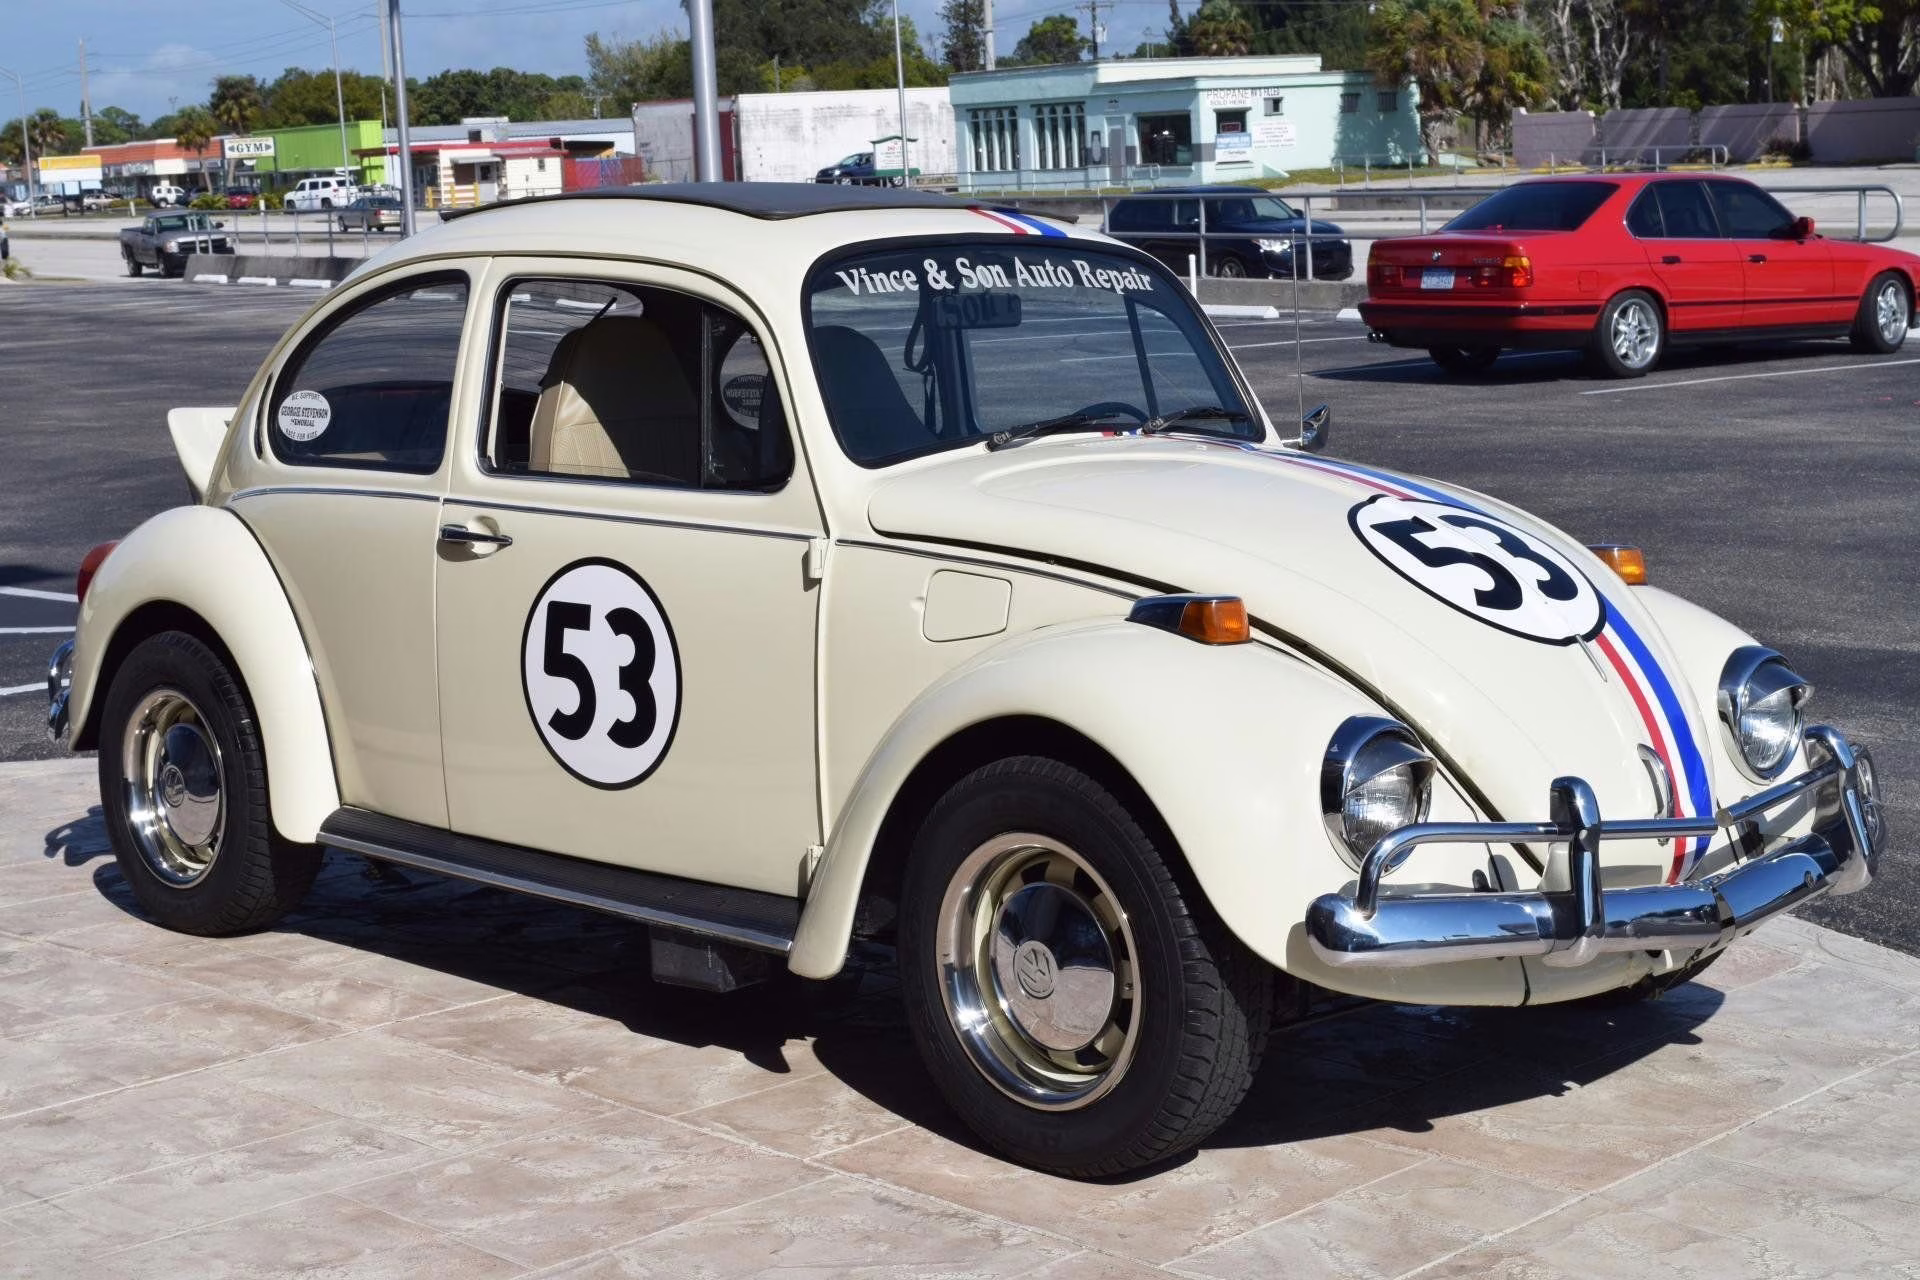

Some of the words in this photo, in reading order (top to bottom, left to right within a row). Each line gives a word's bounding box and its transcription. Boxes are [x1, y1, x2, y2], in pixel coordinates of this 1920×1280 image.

[1207, 88, 1249, 99] PROPANE
[236, 143, 264, 152] GYM
[835, 267, 919, 295] Vince
[923, 258, 953, 290] &
[956, 257, 1011, 289] Son
[1014, 256, 1074, 288] Auto
[1073, 260, 1154, 295] Repair
[1369, 515, 1578, 610] 53
[544, 600, 657, 749] 53
